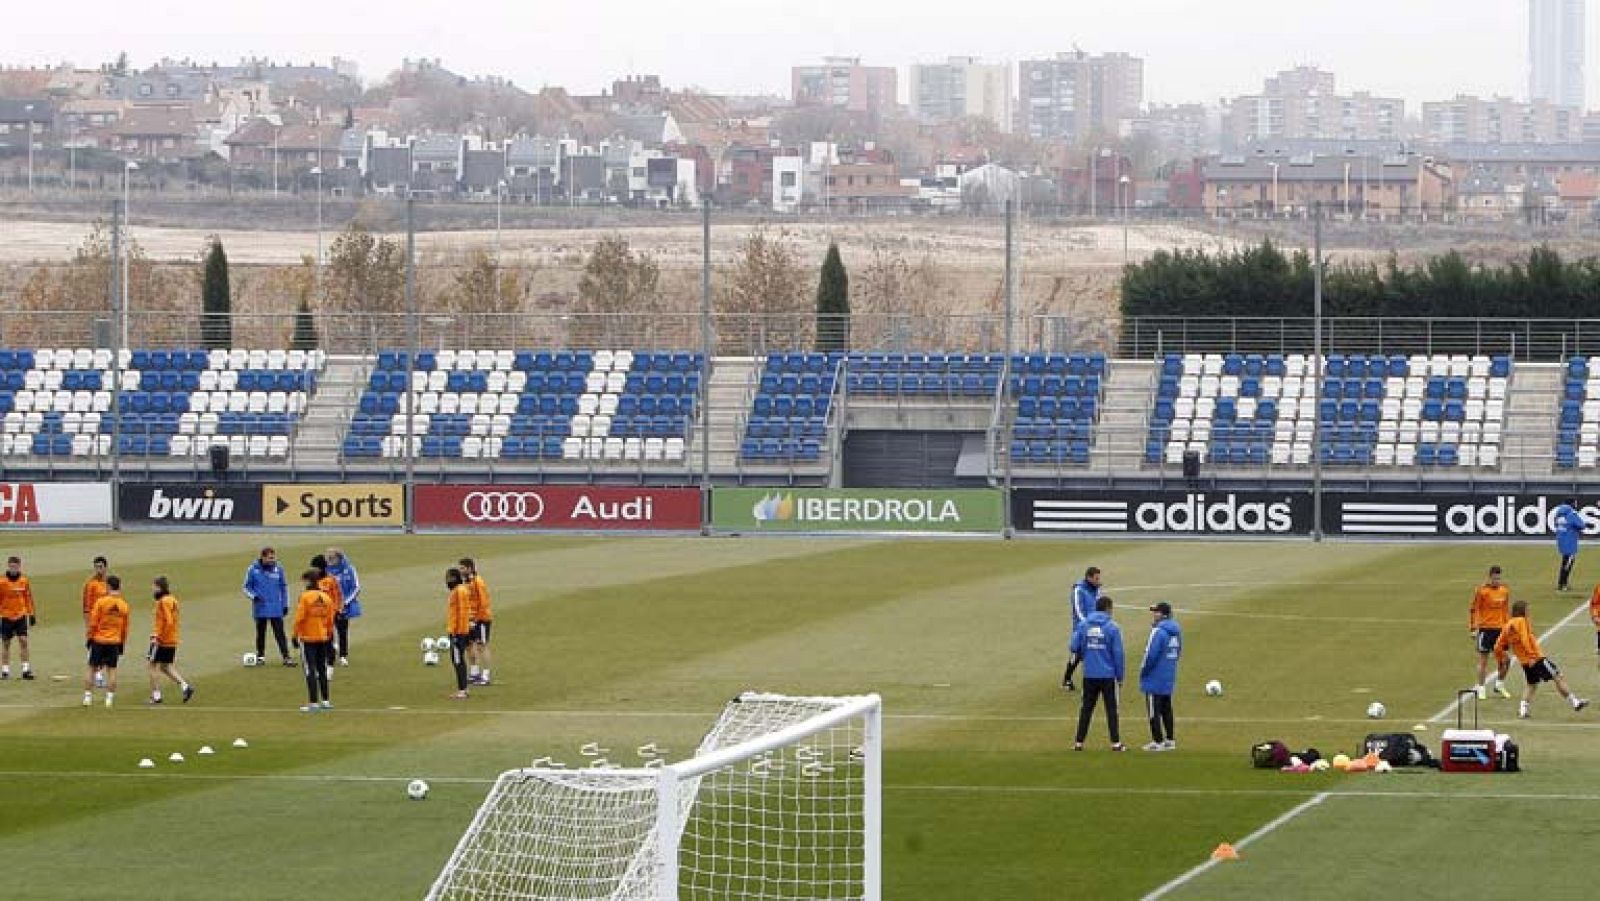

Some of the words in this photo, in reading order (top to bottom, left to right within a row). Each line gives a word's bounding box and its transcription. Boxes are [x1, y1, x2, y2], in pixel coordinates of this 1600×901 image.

[149, 489, 234, 520] bwin
[300, 493, 393, 523] Sports
[571, 496, 653, 520] Audi
[797, 498, 960, 522] IBERDROLA
[1135, 493, 1293, 533] adidas
